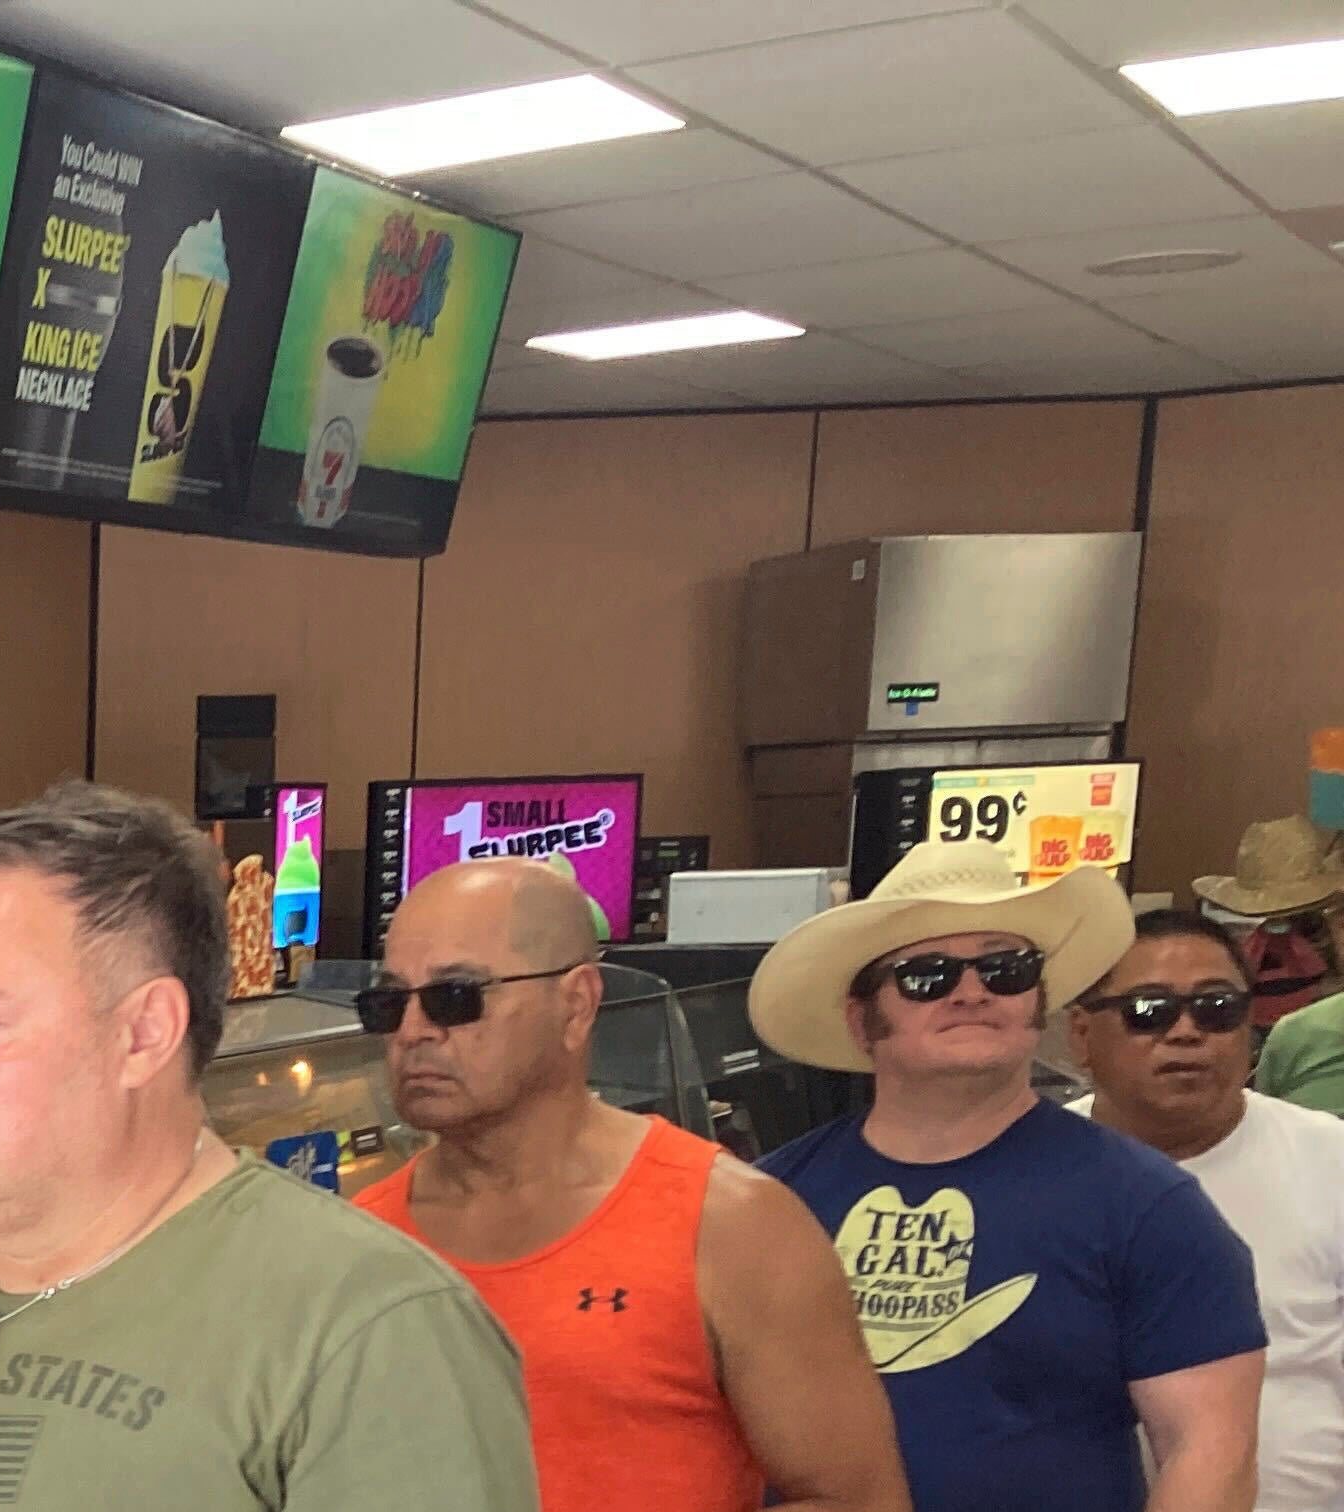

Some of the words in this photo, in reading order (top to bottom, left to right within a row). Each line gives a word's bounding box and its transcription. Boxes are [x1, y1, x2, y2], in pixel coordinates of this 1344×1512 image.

[53, 174, 70, 201] an
[43, 214, 126, 274] SLURPEE
[32, 267, 52, 309] X
[22, 320, 71, 367] KING
[69, 331, 103, 373] ICE
[15, 366, 95, 412] NECKLACE
[486, 800, 566, 828] SMALL
[865, 1207, 951, 1243] TEN
